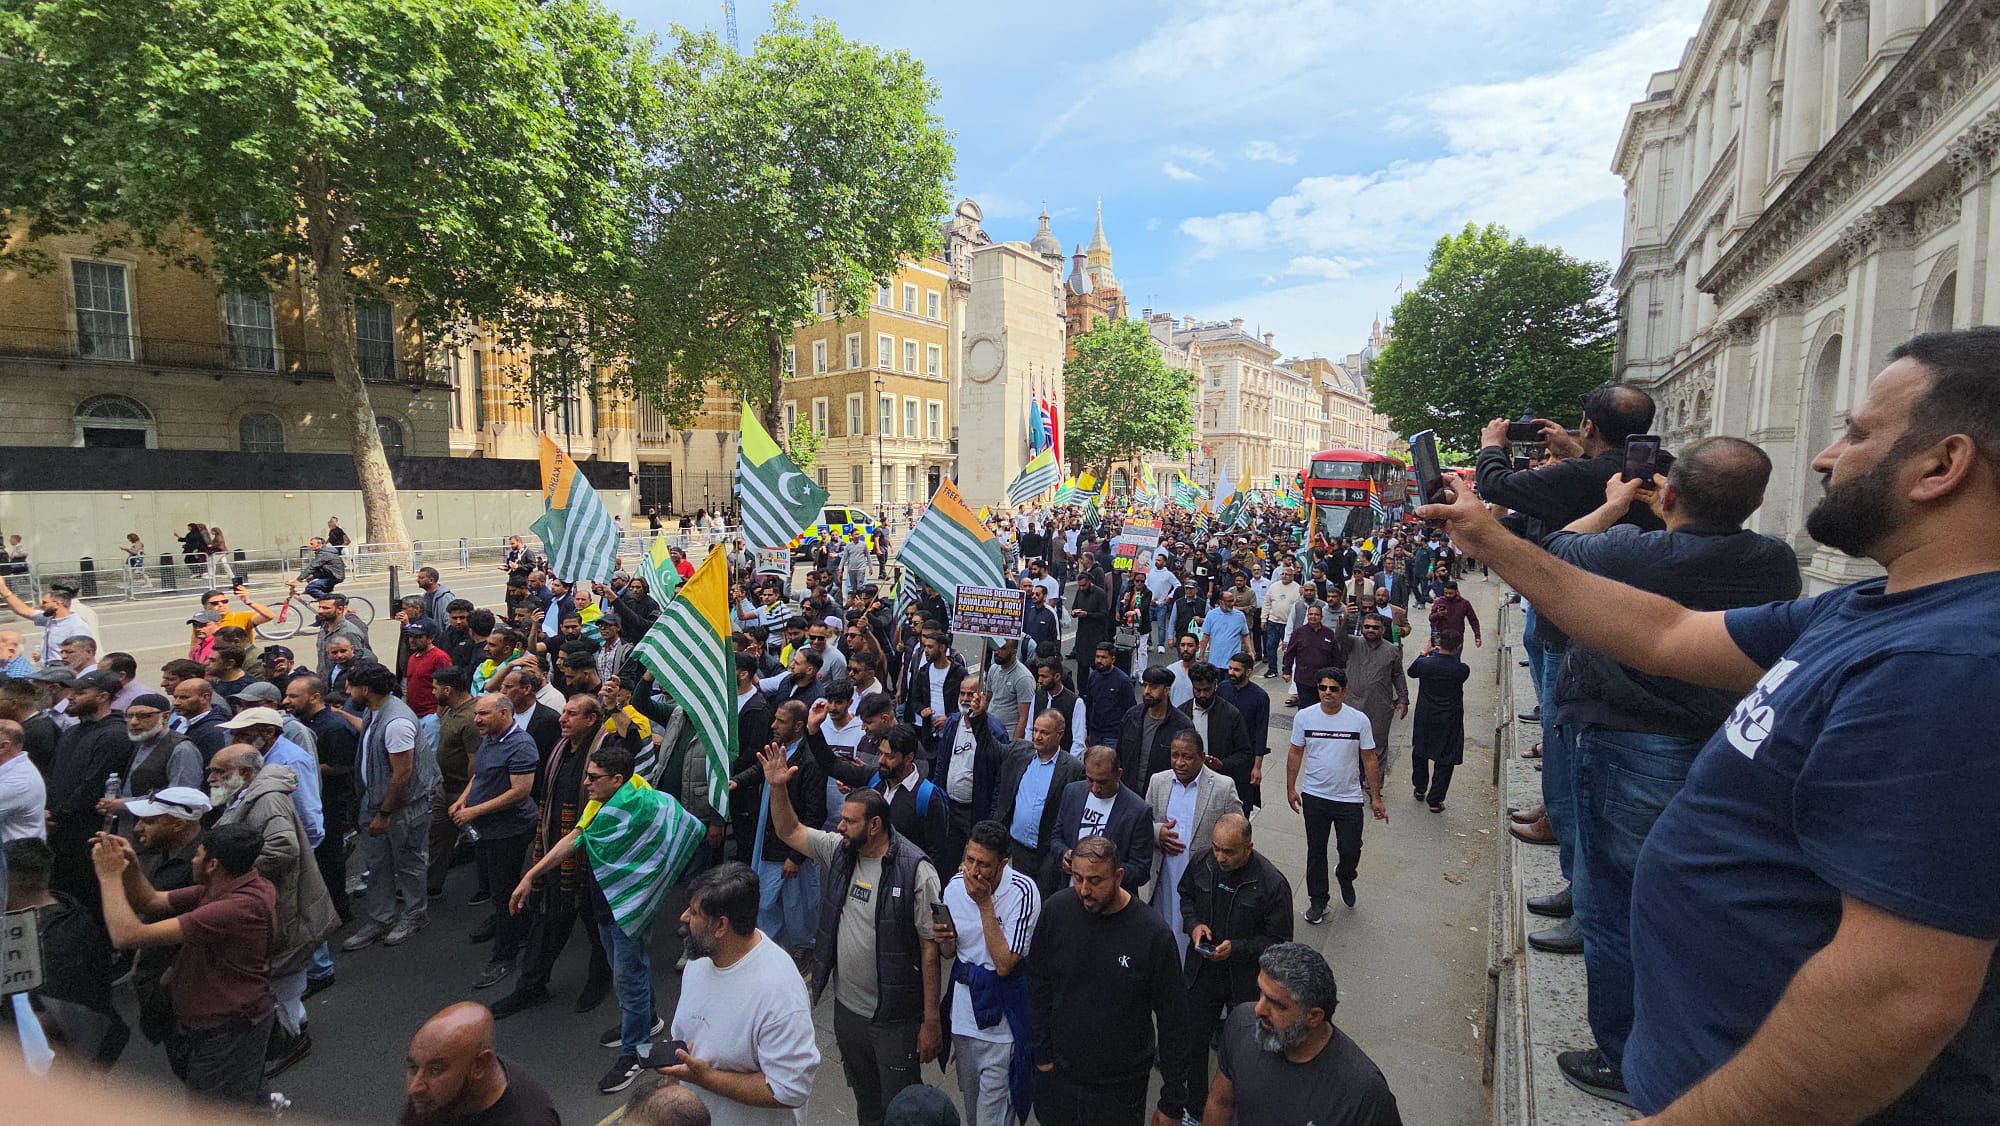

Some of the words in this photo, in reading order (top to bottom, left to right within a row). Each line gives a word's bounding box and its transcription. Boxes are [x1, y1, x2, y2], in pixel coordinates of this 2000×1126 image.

[943, 487, 960, 501] FREE
[776, 551, 787, 560] END
[1113, 556, 1133, 571] 804
[959, 586, 993, 597] KASHMIRIS
[994, 590, 1020, 599] DEMAND
[958, 597, 997, 608] RAWALAKOT
[1004, 601, 1022, 610] KOTLI
[975, 605, 1002, 614] KASHMIR
